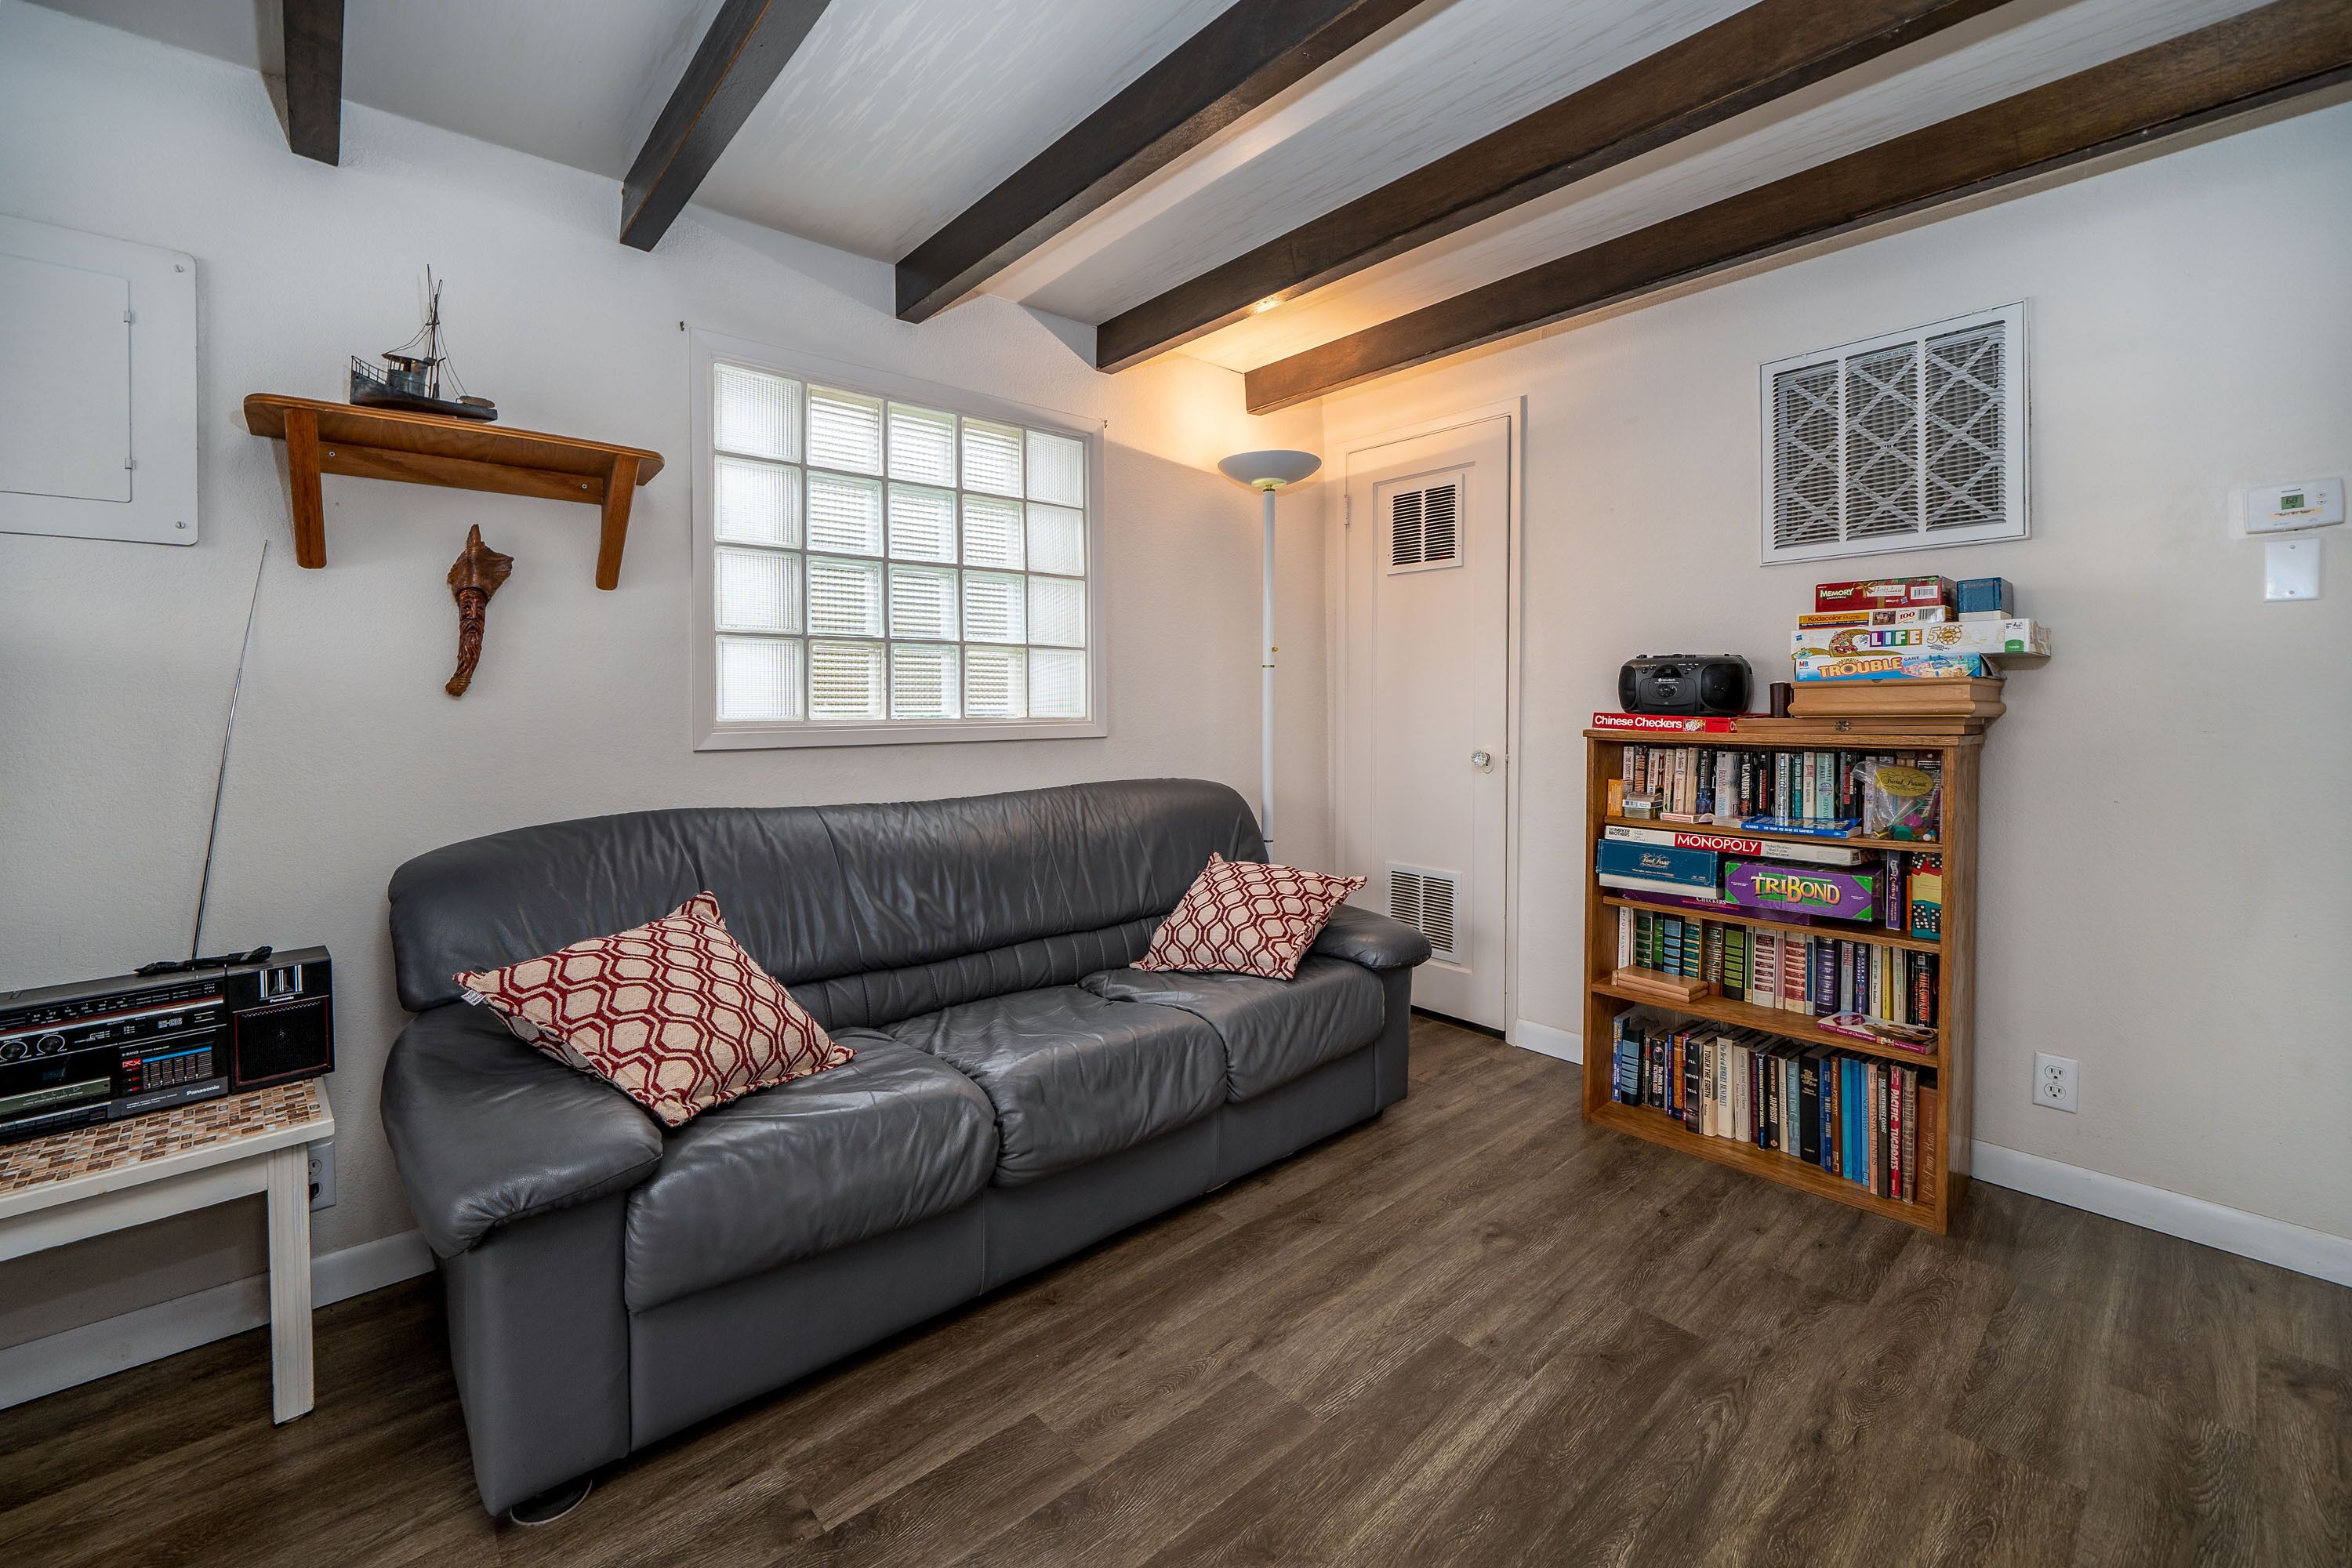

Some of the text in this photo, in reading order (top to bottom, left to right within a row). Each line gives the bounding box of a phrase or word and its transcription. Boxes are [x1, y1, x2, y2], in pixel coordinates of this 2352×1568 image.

[1820, 587, 1855, 597] MEMORY
[1871, 630, 1922, 647] LIFE
[1818, 656, 1904, 680] TROUBLE
[1595, 715, 1682, 729] Chinese Checkers
[1741, 771, 1750, 799] ANDREWS
[1677, 833, 1759, 853] MONOPOLY
[1696, 896, 1726, 905] CHECKERS
[1750, 875, 1841, 905] TRIBOND
[1918, 972, 1929, 1022] FATAL CONVICTIONS
[186, 1084, 220, 1096] Panasonic
[1890, 1088, 1900, 1122] PACIFIC
[1890, 1127, 1899, 1171] TUGBOATS
